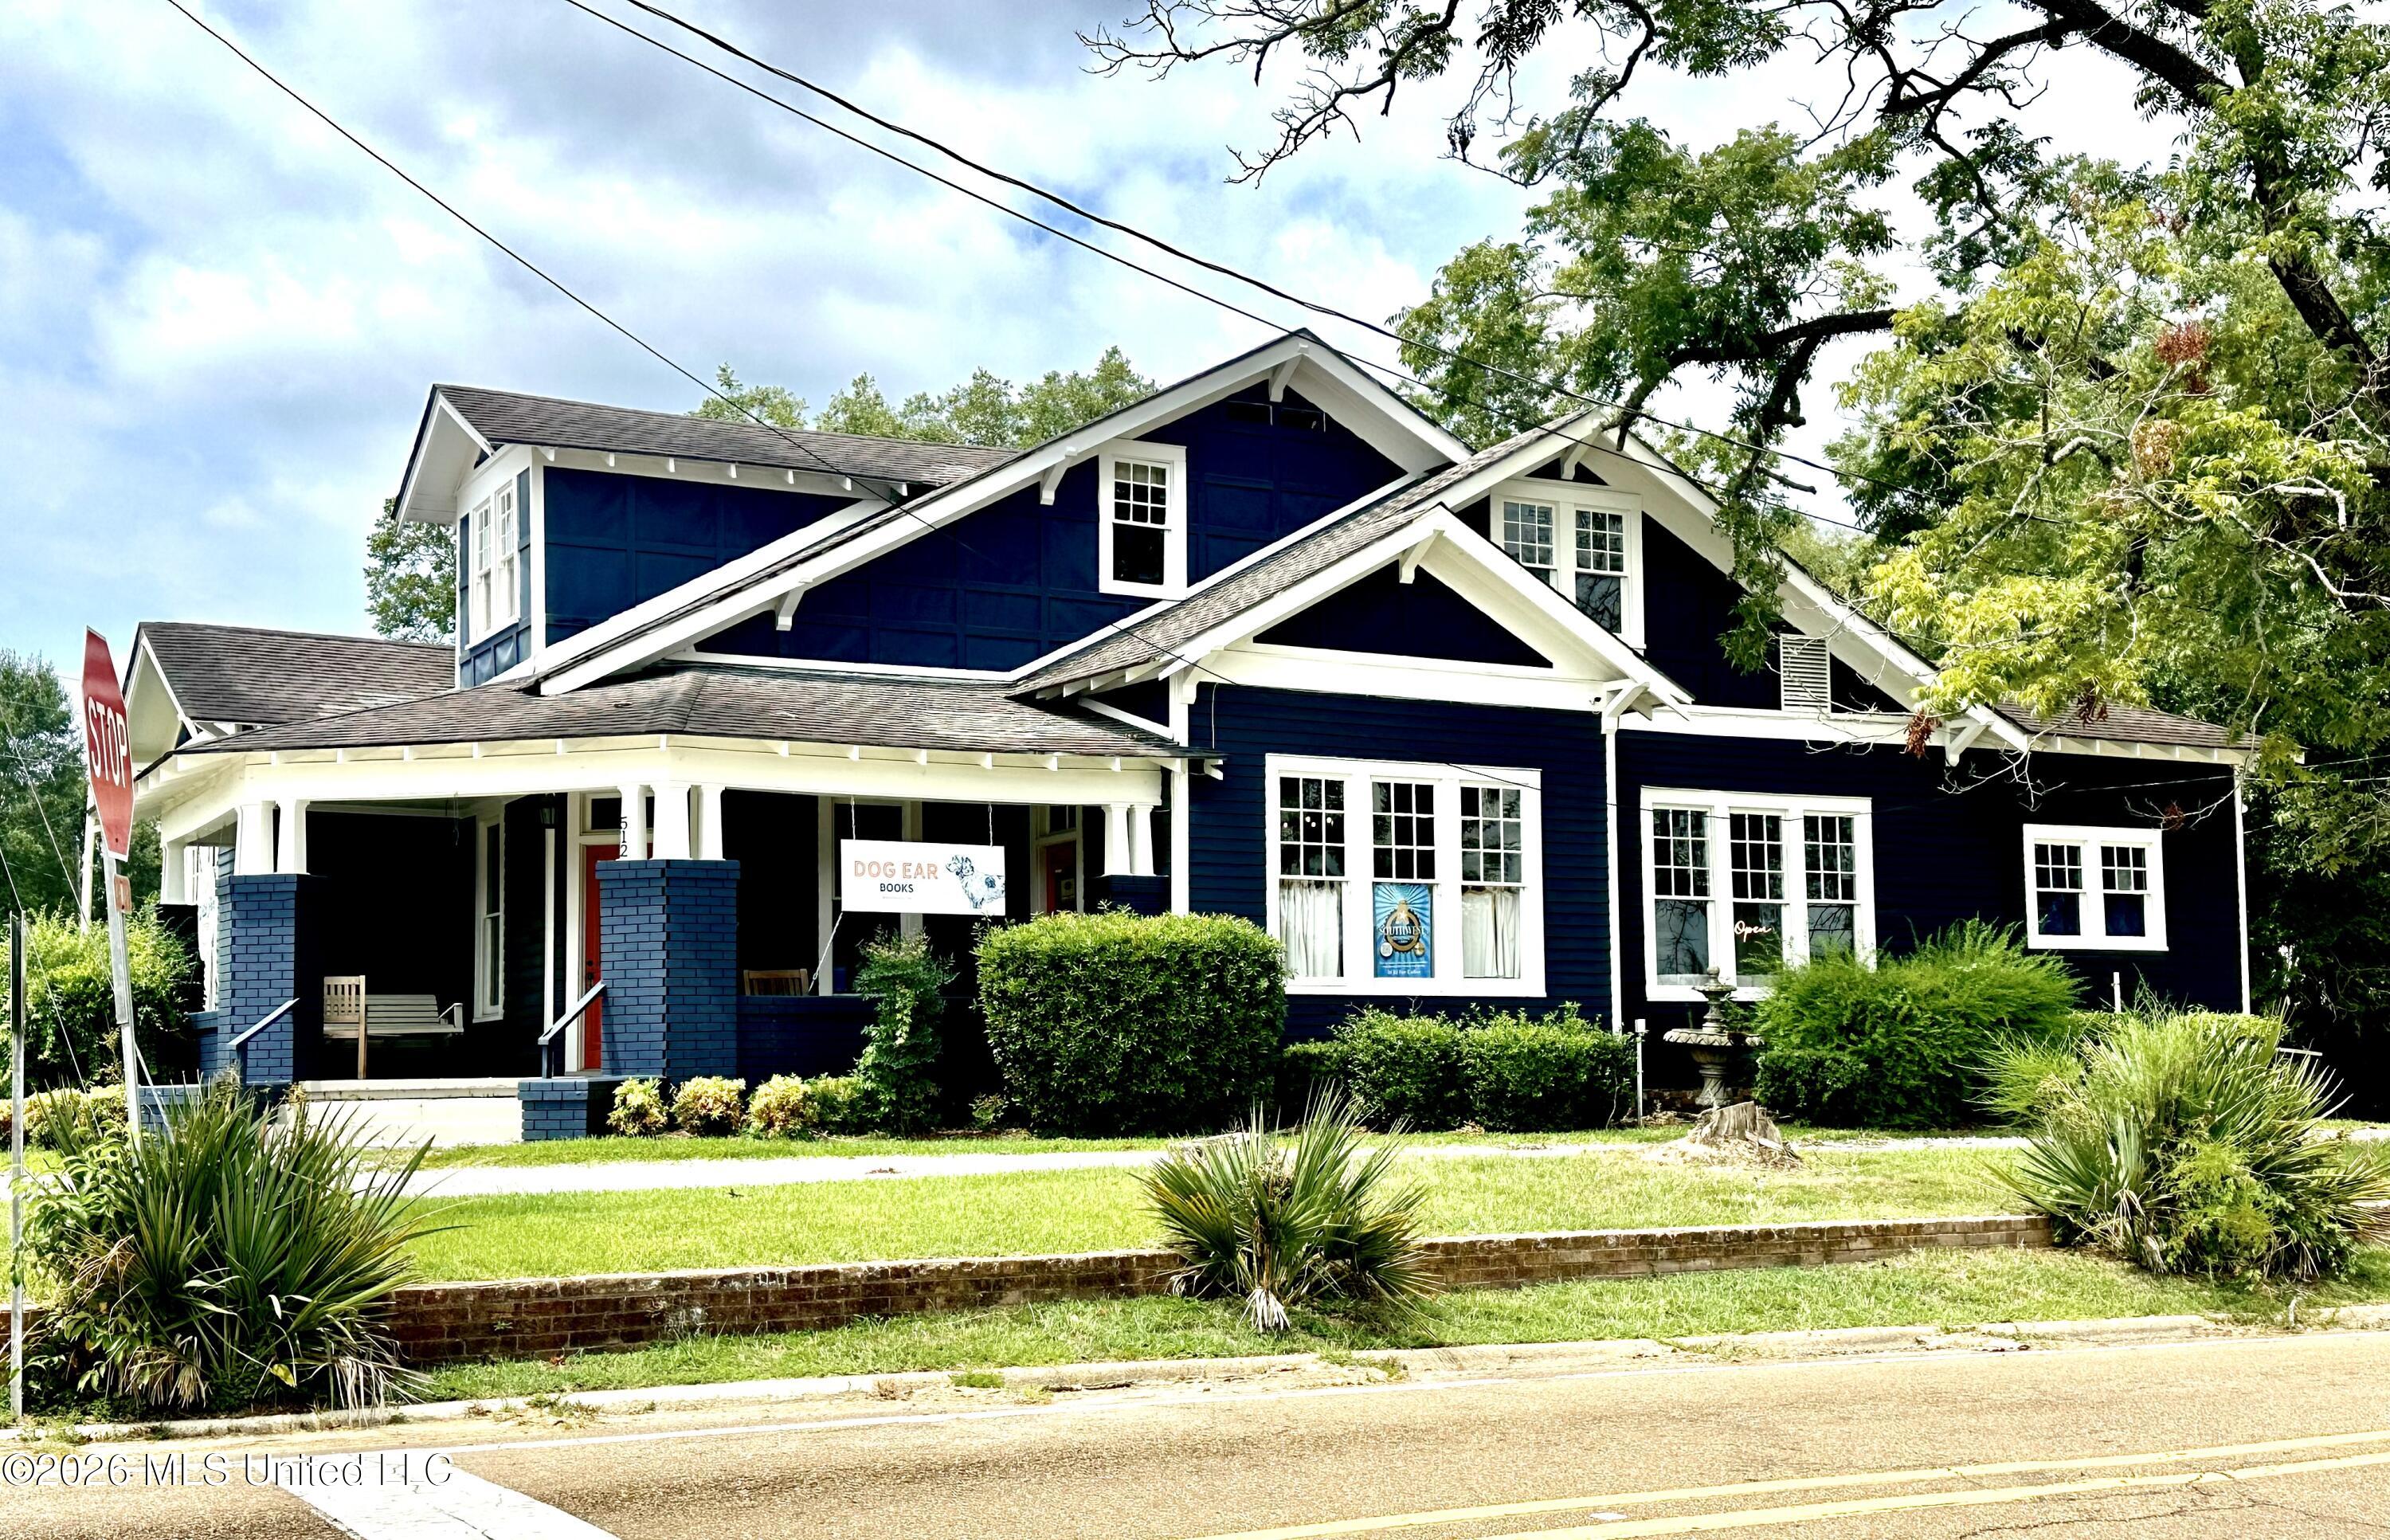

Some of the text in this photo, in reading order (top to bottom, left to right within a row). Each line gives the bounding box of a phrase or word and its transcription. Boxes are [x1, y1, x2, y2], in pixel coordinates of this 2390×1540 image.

[88, 696, 127, 788] STOP
[854, 860, 938, 880] DOG EAR
[880, 883, 914, 892] BOOKS
[1734, 920, 1772, 942] Open
